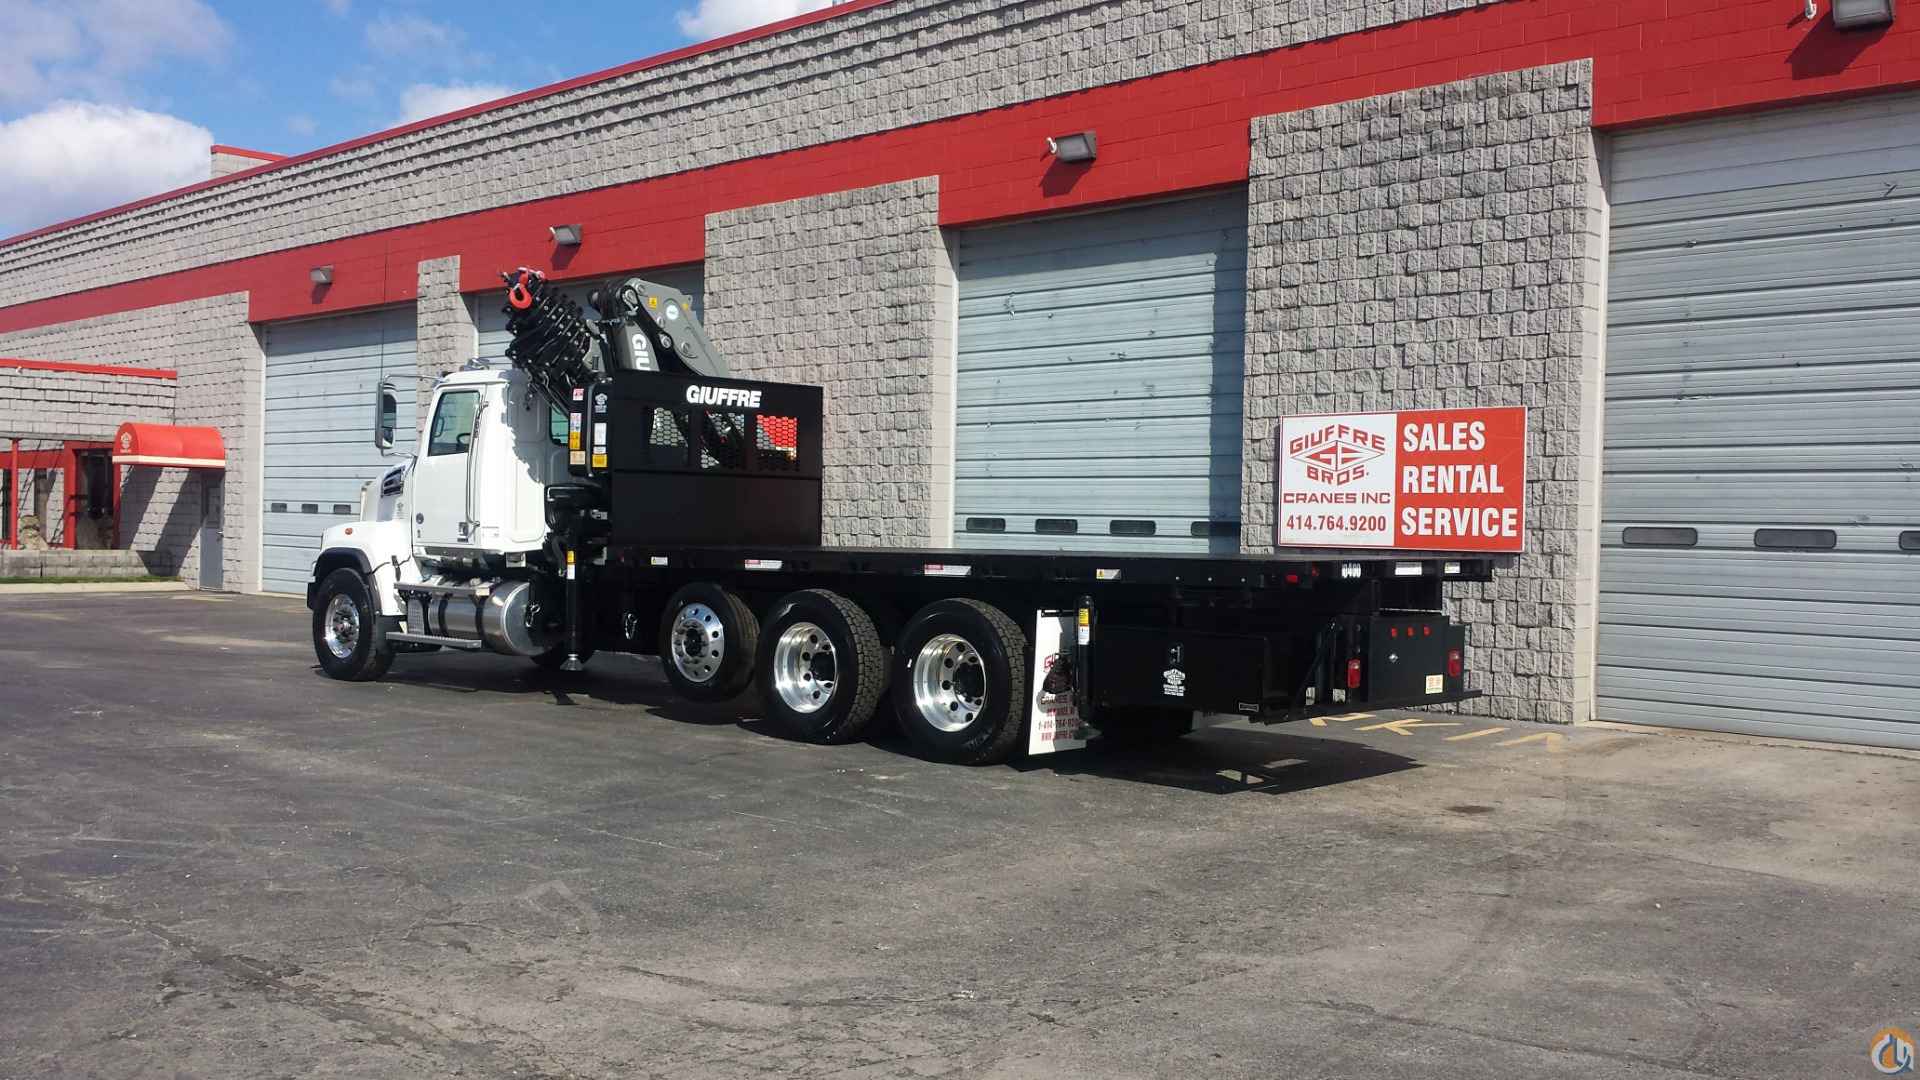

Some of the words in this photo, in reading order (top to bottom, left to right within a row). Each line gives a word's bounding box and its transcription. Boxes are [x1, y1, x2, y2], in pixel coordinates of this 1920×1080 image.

[686, 384, 762, 408] GIUFFRE
[1289, 423, 1386, 455] GIUFFRE
[1403, 421, 1486, 453] SALES
[1306, 464, 1370, 486] BROS.
[1402, 463, 1504, 494] RENTAL
[1283, 492, 1357, 505] CRANES
[1361, 492, 1391, 505] INC
[1286, 514, 1387, 532] 414.764.9200
[1400, 506, 1518, 537] SERVICE
